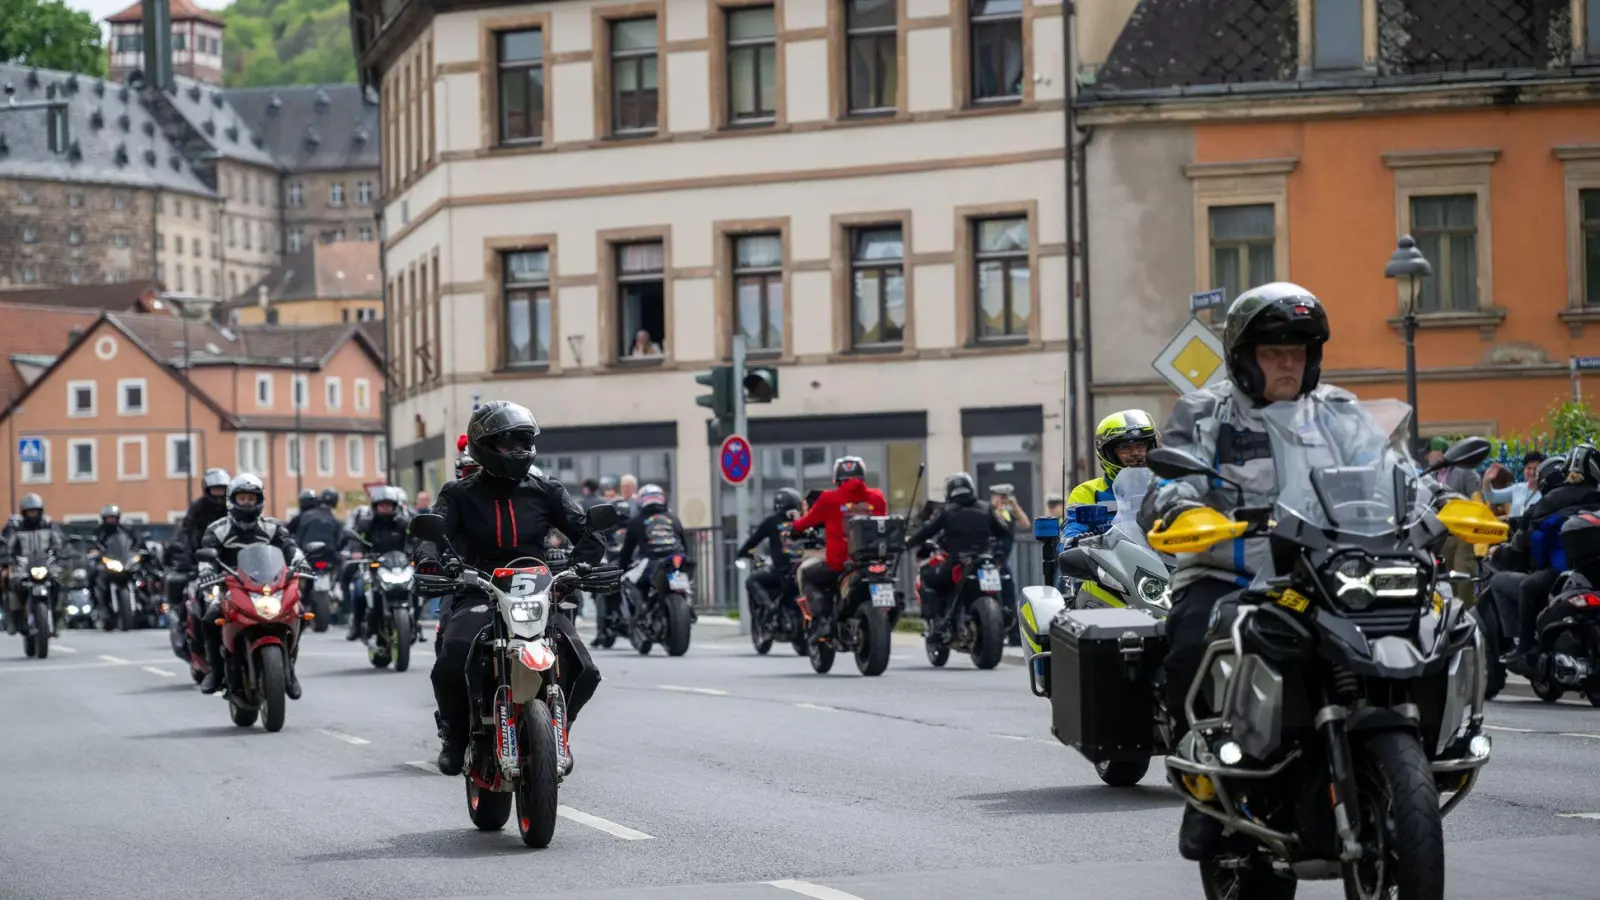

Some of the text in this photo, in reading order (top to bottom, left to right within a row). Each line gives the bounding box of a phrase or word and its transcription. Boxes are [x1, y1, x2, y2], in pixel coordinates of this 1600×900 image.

[509, 574, 537, 597] 5
[500, 705, 509, 757] MICHELIN
[556, 705, 565, 757] MICHELIN
